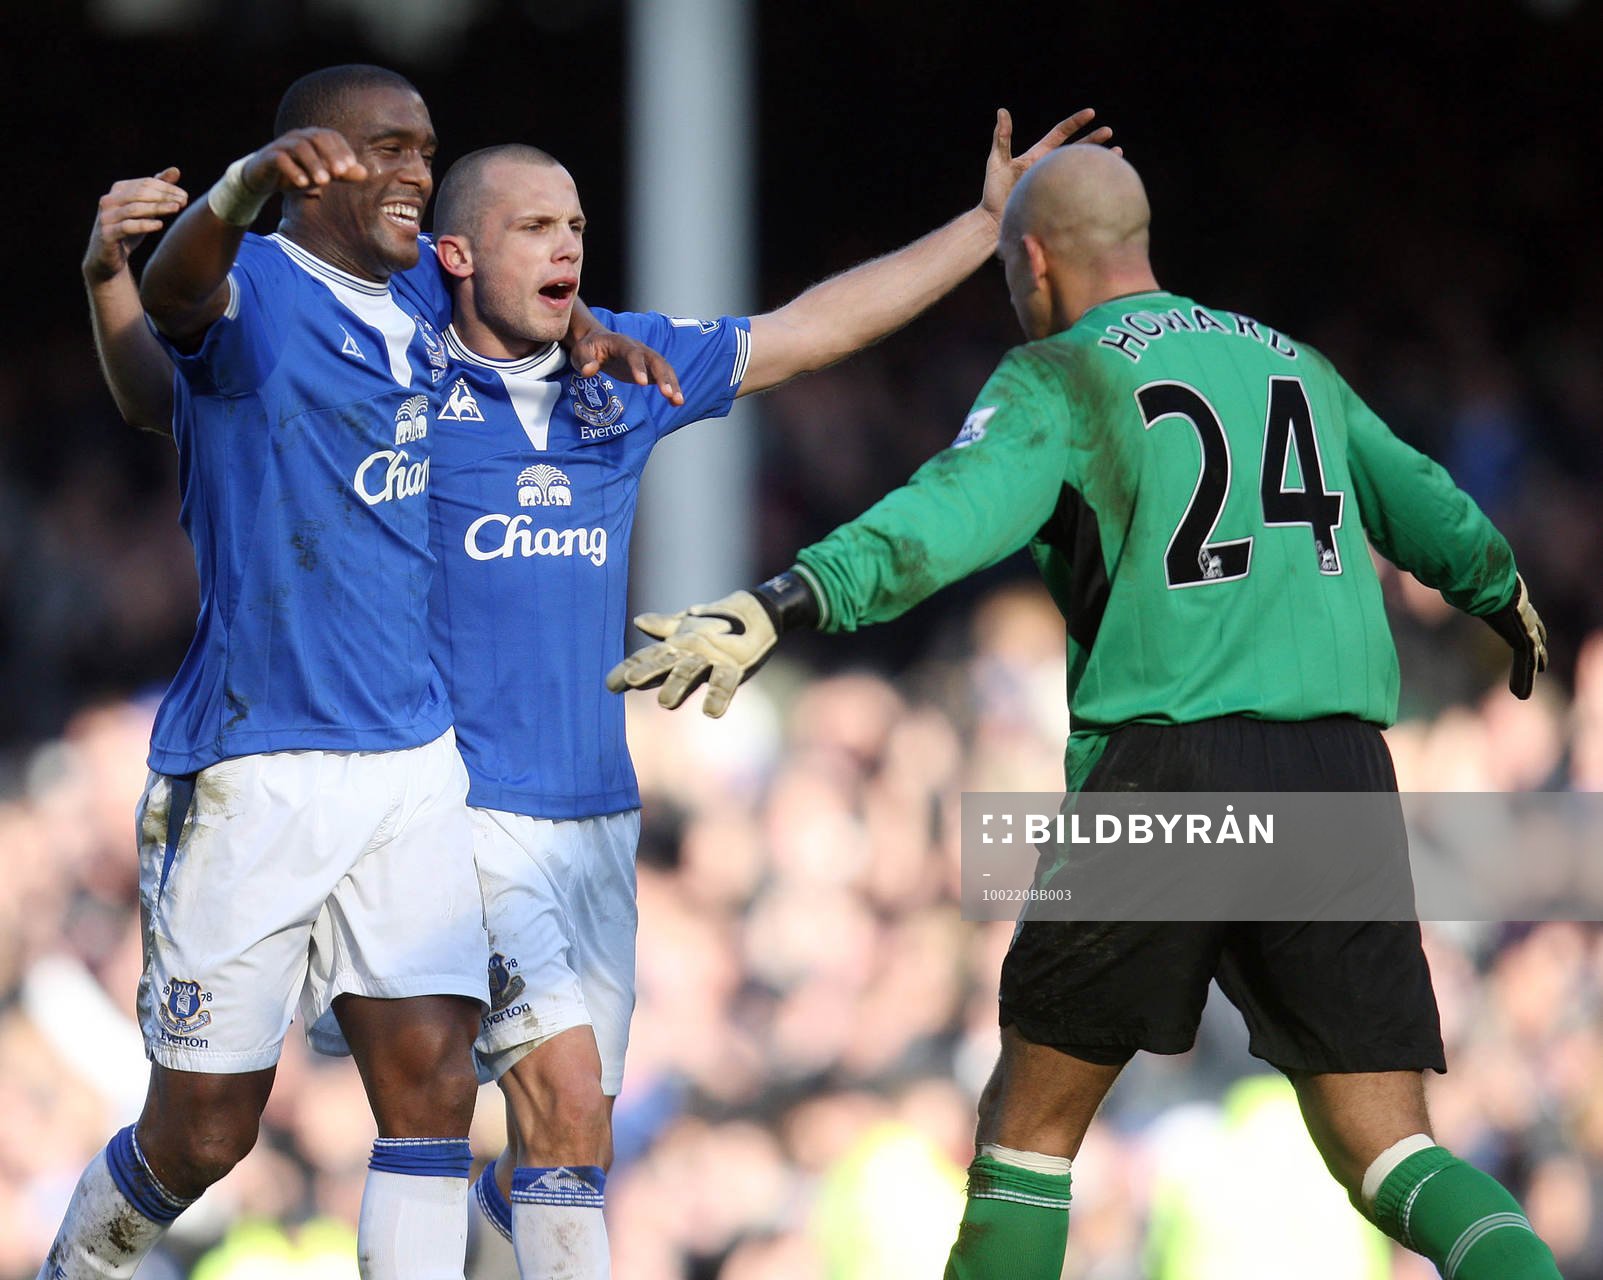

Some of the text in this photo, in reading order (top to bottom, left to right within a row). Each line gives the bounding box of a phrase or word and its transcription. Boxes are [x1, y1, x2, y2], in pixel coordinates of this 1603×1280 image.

[1098, 306, 1298, 363] HOWARD
[603, 380, 614, 390] 78
[580, 422, 629, 440] Everton
[1134, 375, 1345, 590] 24
[465, 513, 607, 566] Chang
[505, 958, 518, 971] 78
[201, 992, 213, 1001] 78
[161, 1029, 208, 1049] Everton
